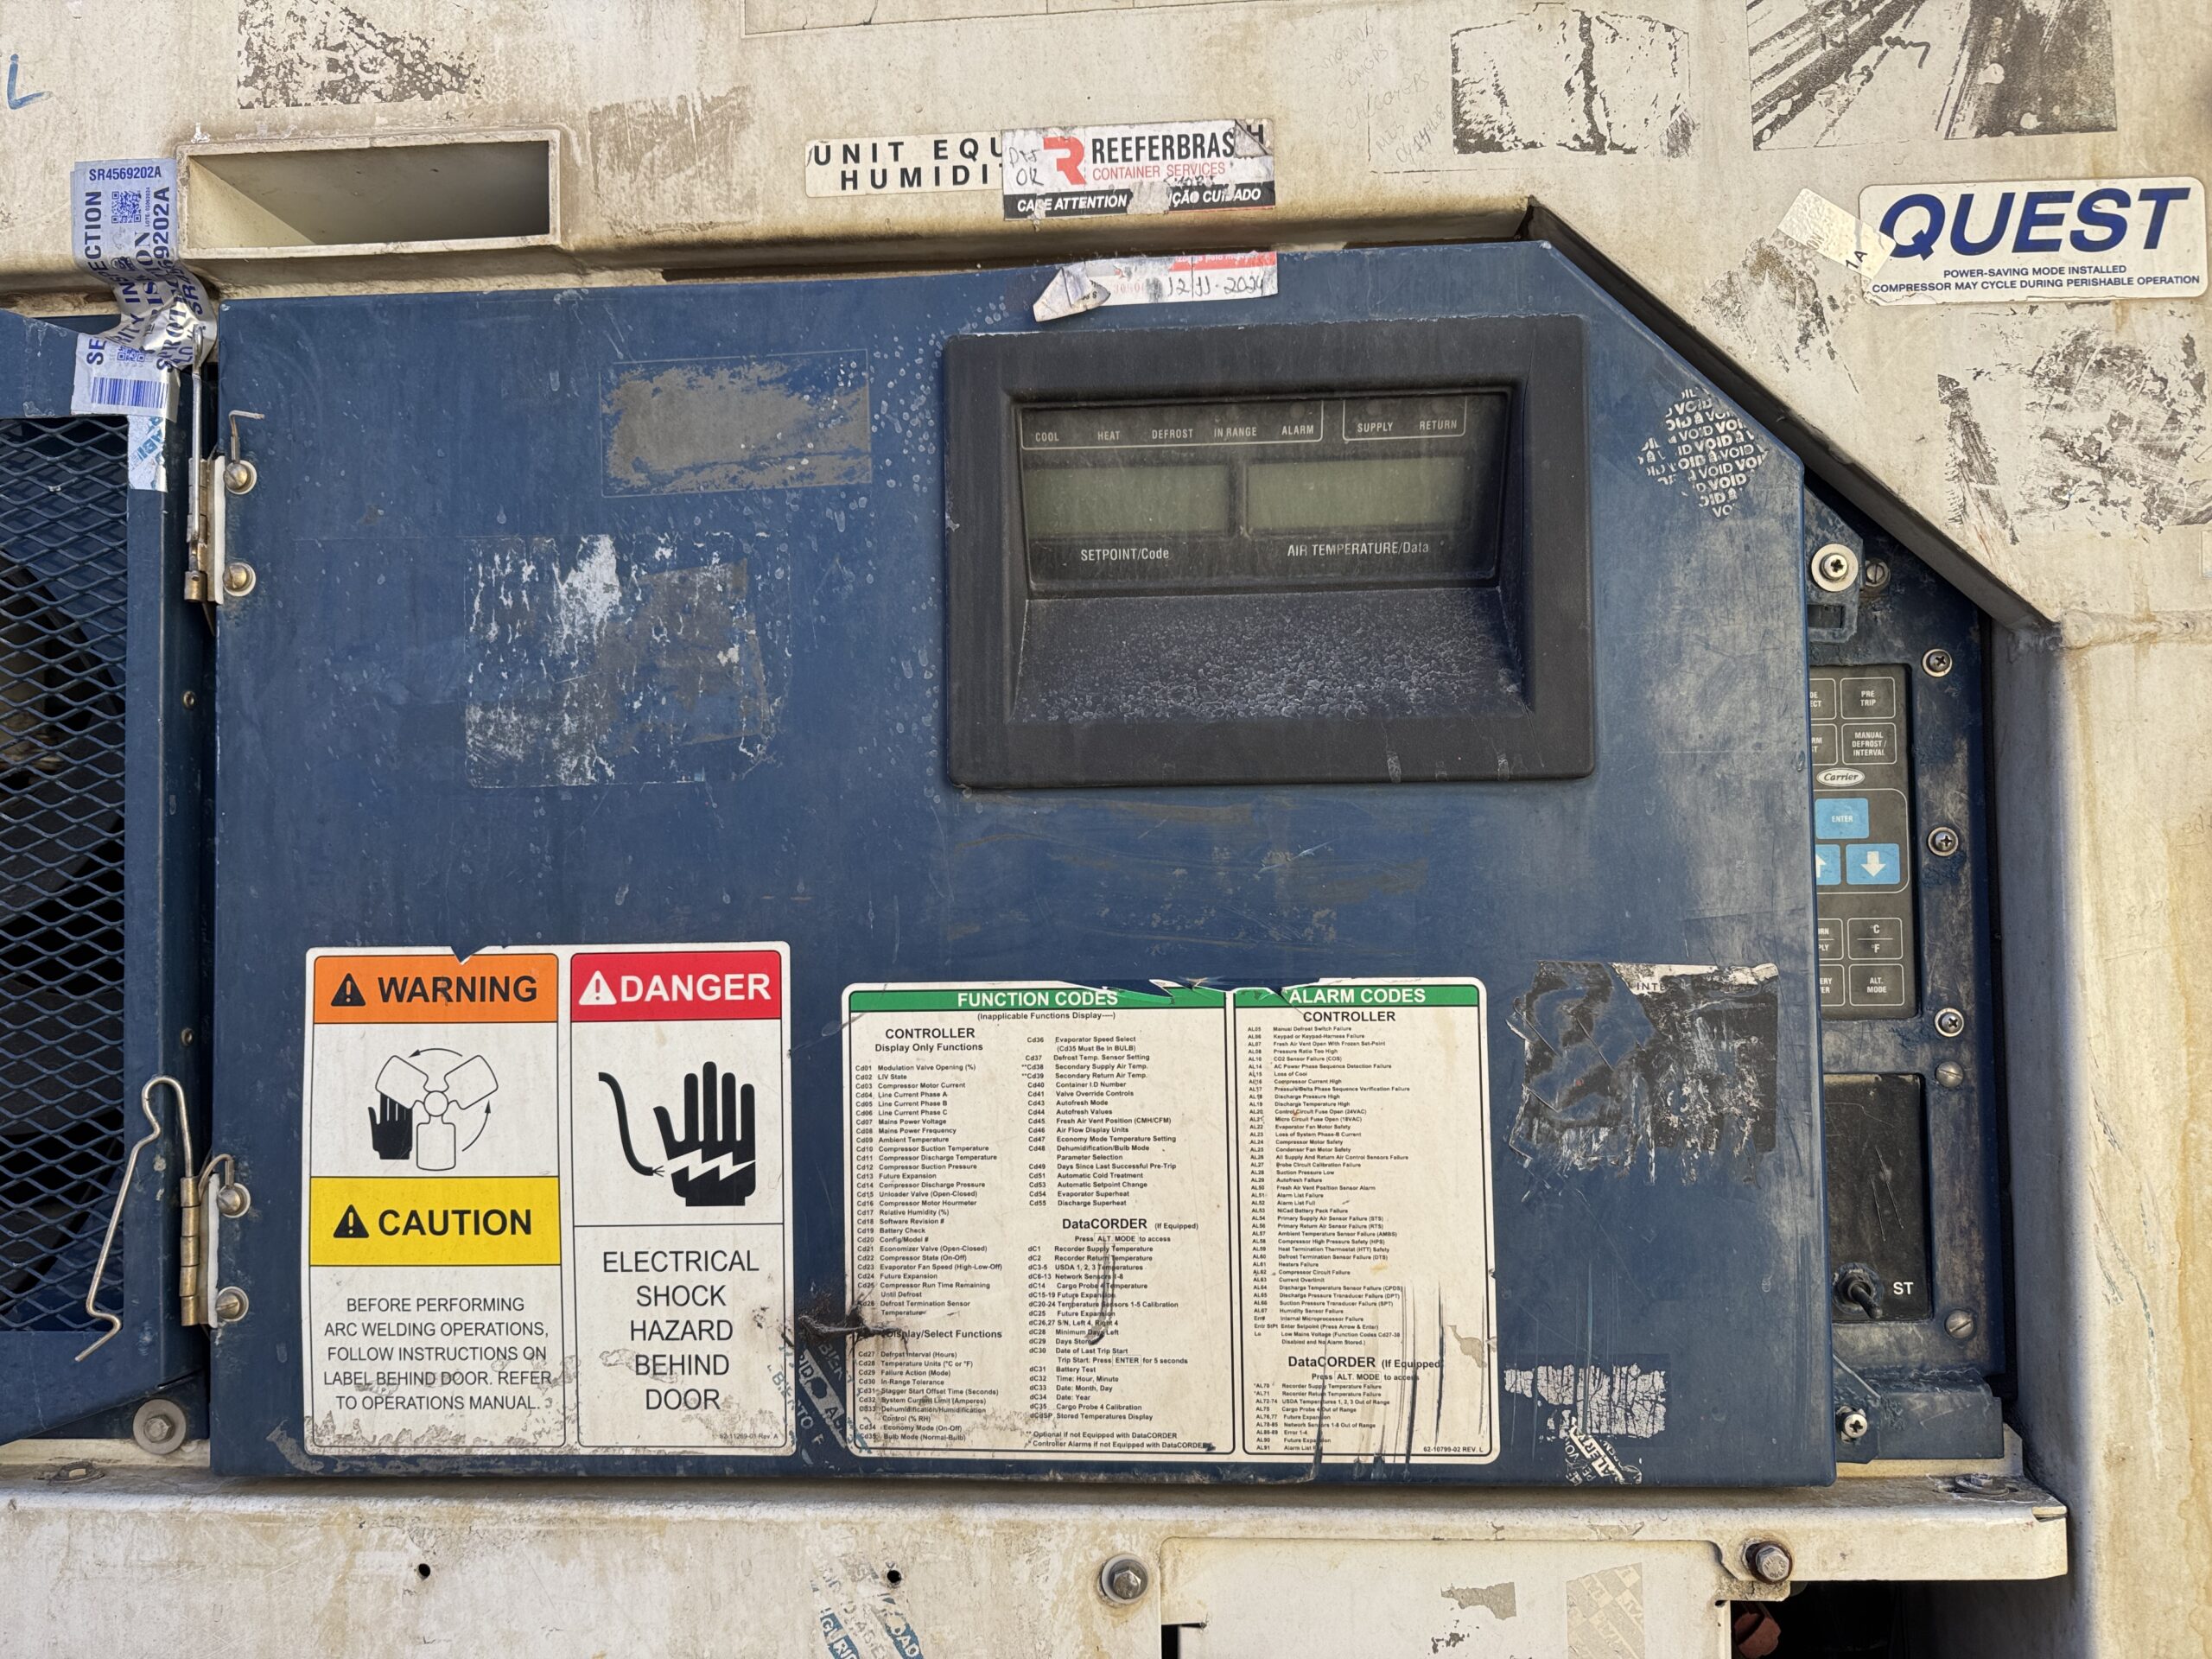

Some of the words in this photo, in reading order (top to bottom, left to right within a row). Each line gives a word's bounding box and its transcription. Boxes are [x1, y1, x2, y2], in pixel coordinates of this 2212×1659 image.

[814, 141, 904, 165] UNIT
[89, 166, 162, 181] SR4569202A
[842, 164, 1001, 191] HUMIDI
[1093, 166, 1160, 181] CONTAINER
[1167, 162, 1225, 176] SERVICES
[1017, 199, 1052, 213] CAE
[1054, 194, 1128, 211] ATTENTION
[1879, 188, 2190, 261] QUEST
[1944, 268, 2029, 278] POWER-SAVING
[2032, 267, 2065, 276] MODE
[2069, 265, 2127, 275] INSTALLED
[1872, 283, 1951, 293] COMPRESSOR
[1955, 282, 1978, 290] MAY
[1981, 281, 2017, 289] CYCLE
[2020, 279, 2063, 289] DURING
[2067, 277, 2133, 287] PERISHABLE
[2137, 276, 2200, 285] OPERATION
[1036, 432, 1059, 442] COOL
[1097, 431, 1120, 440] HEAT
[1152, 429, 1193, 439] DEFROST
[1214, 428, 1224, 438] IN
[1226, 427, 1256, 437] RANGE
[1281, 424, 1314, 435] ALARM
[1357, 421, 1393, 433] SUPPLY
[1420, 419, 1457, 431] RETURN
[1694, 435, 1732, 452] VOID
[1719, 444, 1754, 460] VOID
[1699, 462, 1732, 479] VOID
[1707, 474, 1746, 491] VOID
[1081, 548, 1169, 562] SETPOINT/Code
[1288, 543, 1307, 556] AIR
[1313, 541, 1429, 556] TEMPERATURE/Data
[1832, 815, 1853, 823] ENTER
[378, 976, 537, 1003] WARNING
[621, 973, 771, 1002] DANGER
[1289, 989, 1354, 1003] ALARM
[1361, 988, 1426, 1003] CODES
[957, 992, 1049, 1007] FUNCTION
[1055, 991, 1118, 1006] CODES
[977, 1013, 1028, 1021] (Inapplicable
[1303, 1011, 1395, 1022] CONTROLLER
[886, 1028, 975, 1039] CONTROLLER
[875, 1044, 909, 1052] Display
[912, 1044, 933, 1052] Only
[378, 1209, 532, 1236] CAUTION
[1063, 1218, 1147, 1230] DataCORDER
[603, 1249, 760, 1273] ELECTRICAL
[636, 1285, 727, 1307] SHOCK
[1893, 1281, 1914, 1294] ST
[347, 1298, 412, 1313] BEFORE
[416, 1297, 524, 1312] PERFORMING
[324, 1322, 359, 1337] ARC
[361, 1322, 435, 1337] WELDING
[440, 1321, 549, 1338] OPERATIONS,
[631, 1319, 733, 1342] HAZARD
[956, 1330, 1002, 1338] Functions
[327, 1346, 395, 1361] FOLLOW
[398, 1346, 518, 1361] INSTRUCTIONS
[524, 1346, 546, 1360] ON
[636, 1354, 729, 1376] BEHIND
[1288, 1357, 1376, 1367] DataCORDER
[1381, 1360, 1392, 1369] (If
[324, 1371, 372, 1385] LABEL
[376, 1371, 436, 1385] BEHIND
[440, 1371, 493, 1385] DOOR.
[498, 1370, 551, 1385] REFER
[336, 1395, 358, 1410] TO
[362, 1395, 464, 1410] OPERATIONS
[468, 1395, 541, 1410] MANUAL.
[645, 1388, 721, 1411] DOOR
